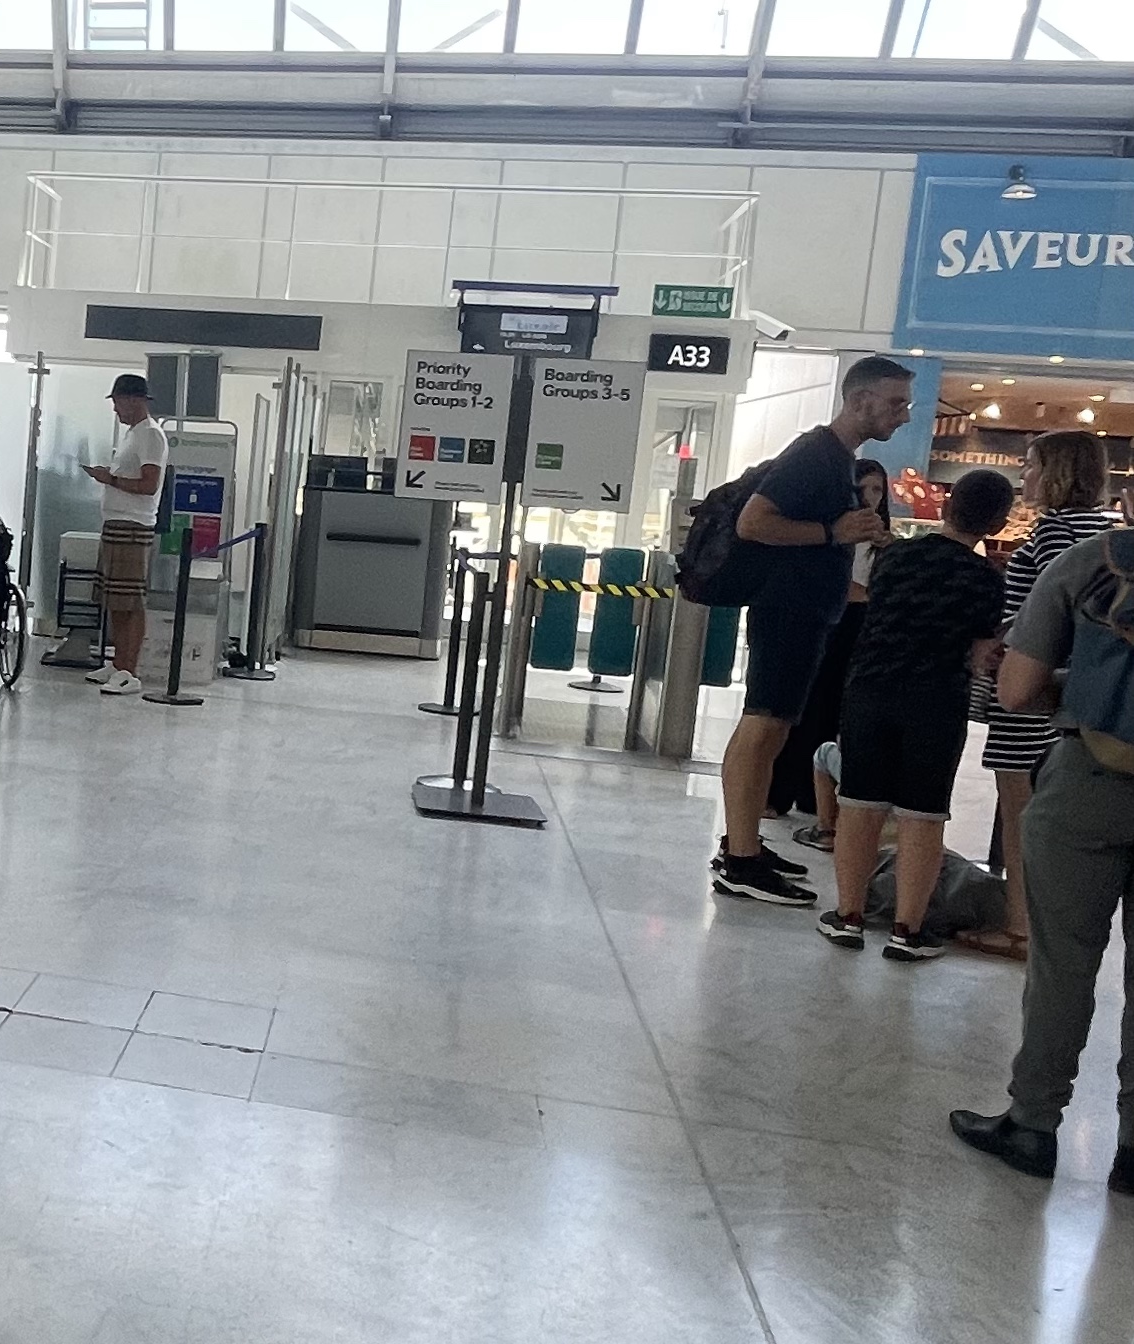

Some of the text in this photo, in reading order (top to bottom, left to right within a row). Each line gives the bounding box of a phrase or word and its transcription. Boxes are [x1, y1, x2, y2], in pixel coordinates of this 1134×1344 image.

[936, 229, 1134, 278] SAVEUR
[667, 344, 711, 368] A33
[416, 360, 472, 378] Priority
[543, 368, 614, 387] Boarding
[415, 376, 483, 396] Boarding
[542, 384, 632, 401] Groups 3-5
[413, 392, 494, 409] Groups 1-2
